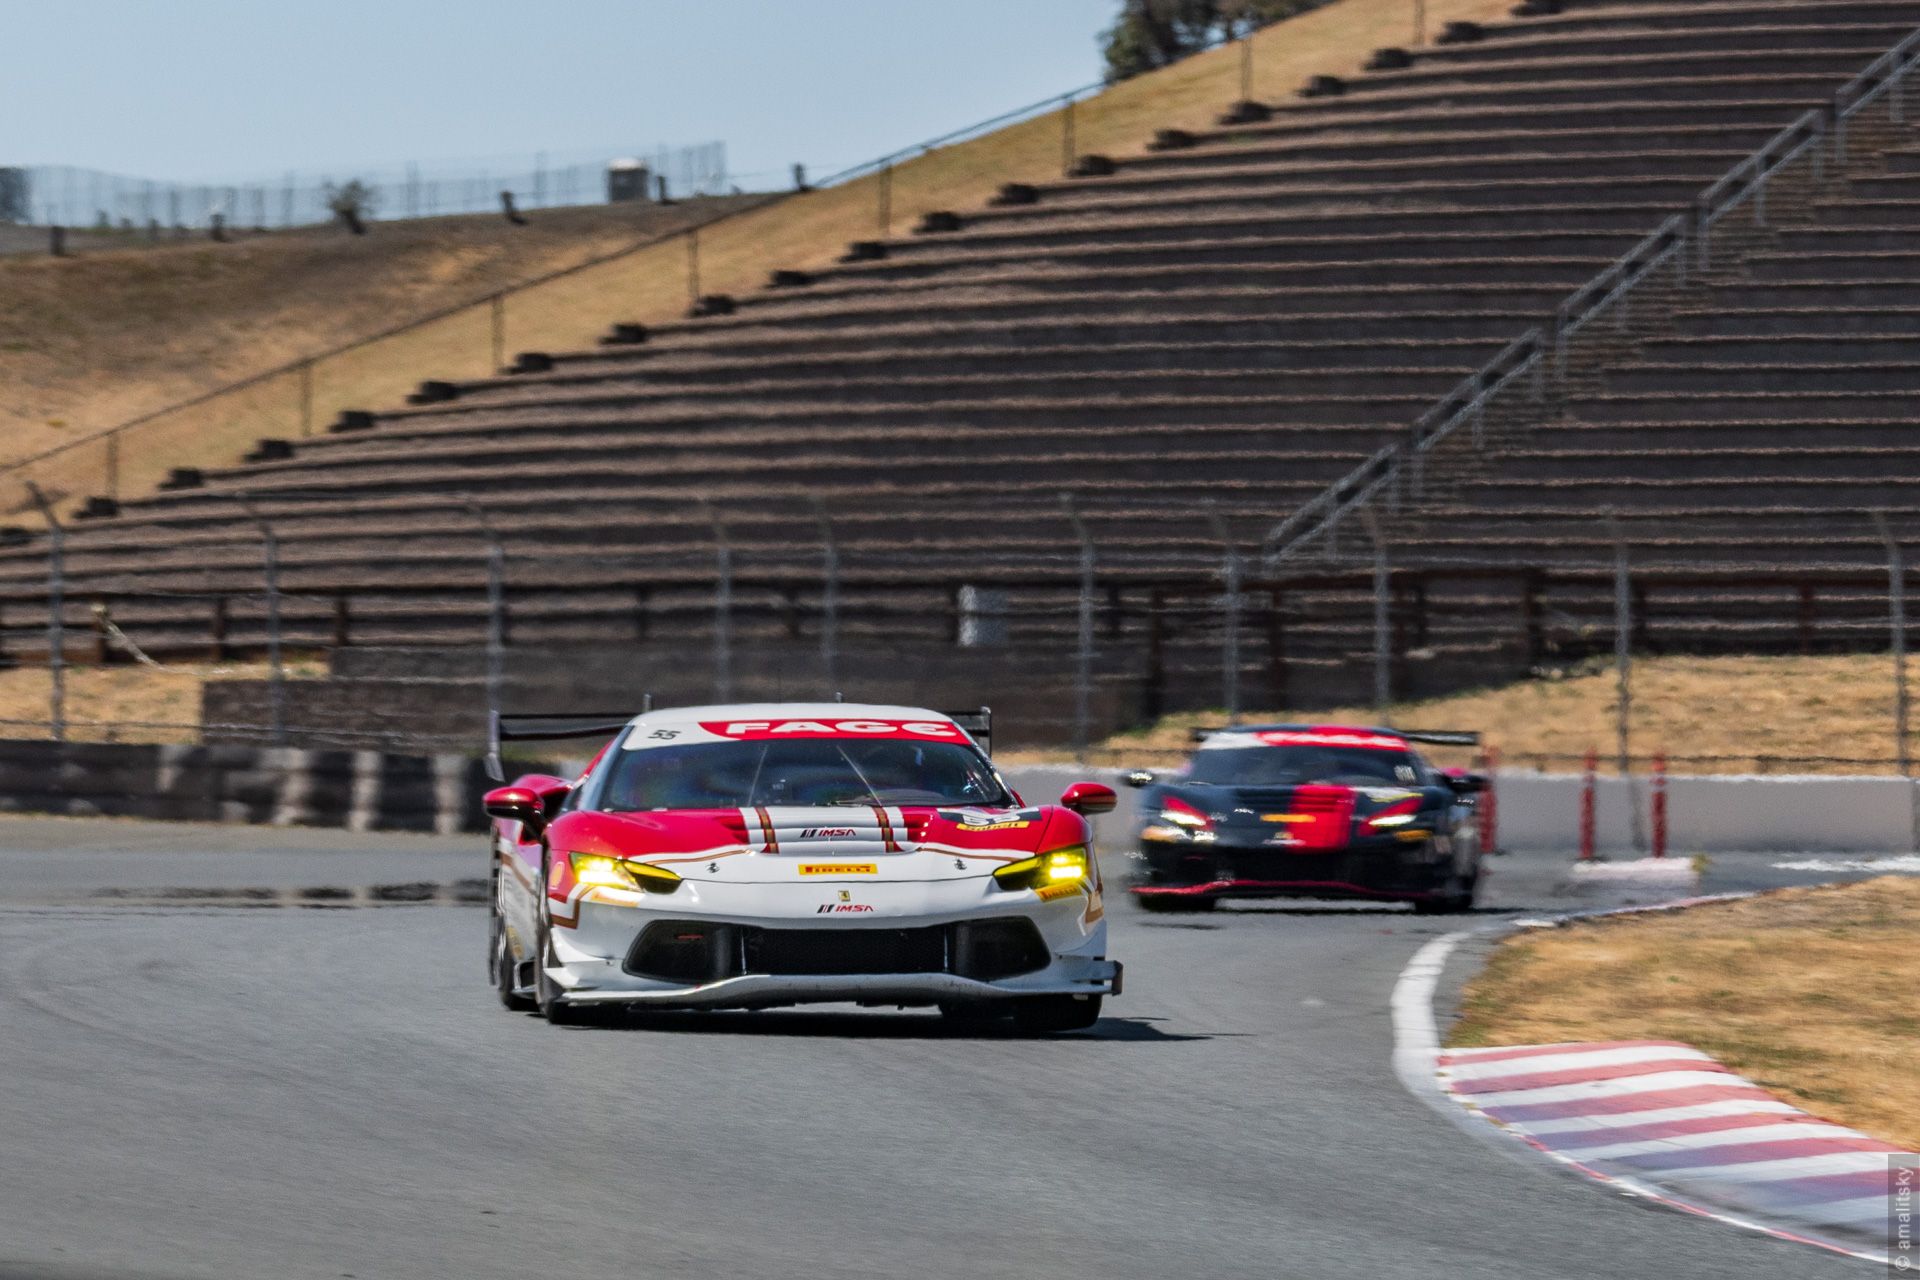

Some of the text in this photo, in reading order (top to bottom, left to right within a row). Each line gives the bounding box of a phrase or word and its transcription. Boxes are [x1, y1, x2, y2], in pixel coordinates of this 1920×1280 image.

[726, 720, 957, 737] FAGE
[648, 729, 681, 740] 55
[818, 828, 857, 837] IMSA
[835, 904, 874, 912] IMSA
